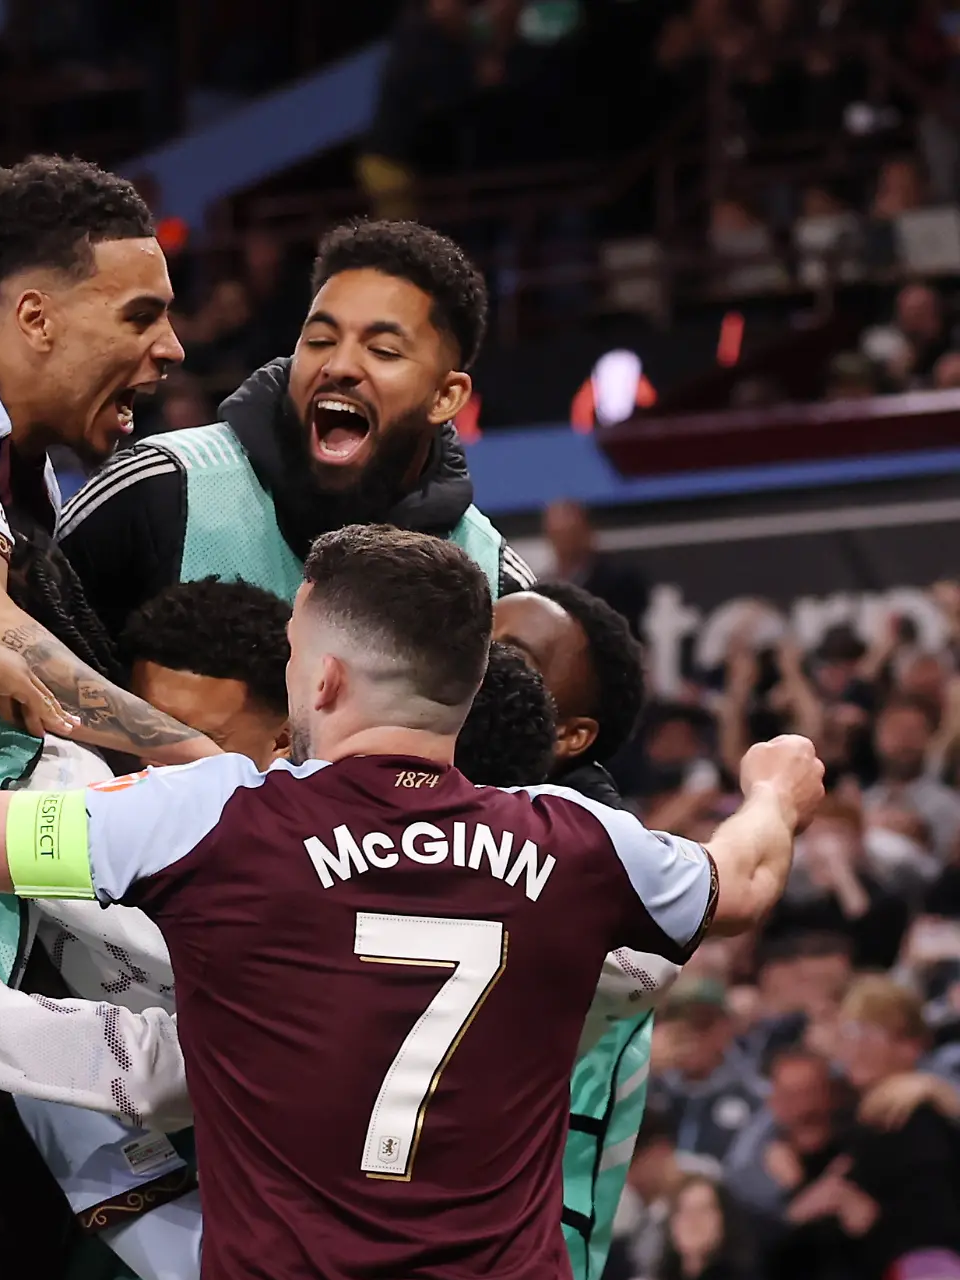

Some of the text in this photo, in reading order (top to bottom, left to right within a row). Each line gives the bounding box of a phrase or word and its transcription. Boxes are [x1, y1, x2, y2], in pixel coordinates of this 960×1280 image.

[394, 771, 440, 790] 1874
[303, 822, 557, 902] McGINN
[353, 912, 510, 1182] 7
